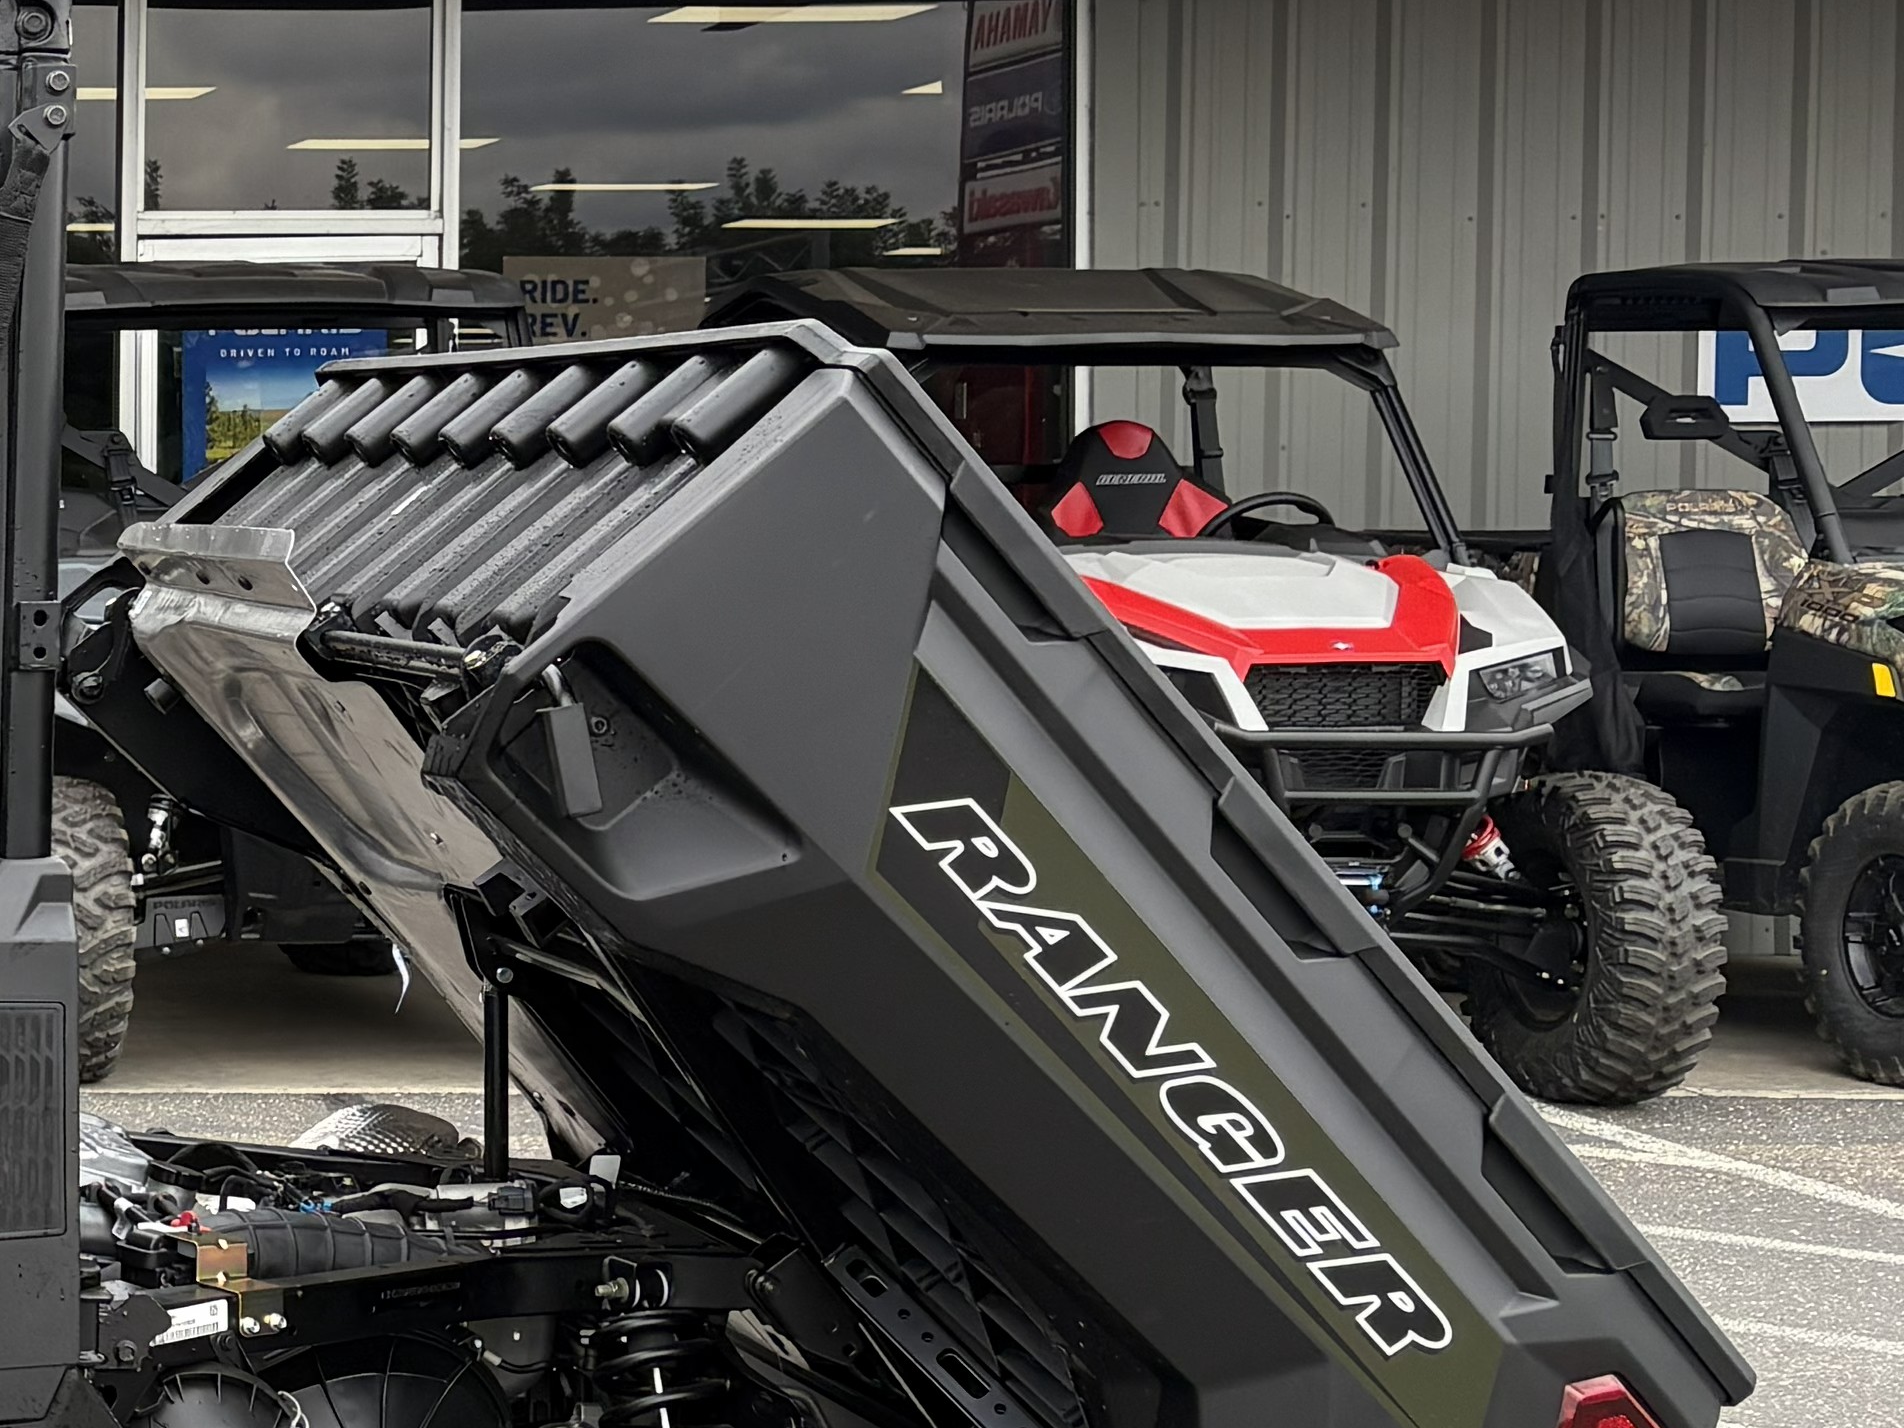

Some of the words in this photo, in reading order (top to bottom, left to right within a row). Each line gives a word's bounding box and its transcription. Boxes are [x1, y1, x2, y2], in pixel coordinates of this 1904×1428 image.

[519, 279, 599, 305] RIDE.
[220, 347, 275, 358] DRIVEN
[285, 347, 301, 357] TO
[310, 346, 350, 357] ROAM
[890, 798, 1453, 1356] RANGER
